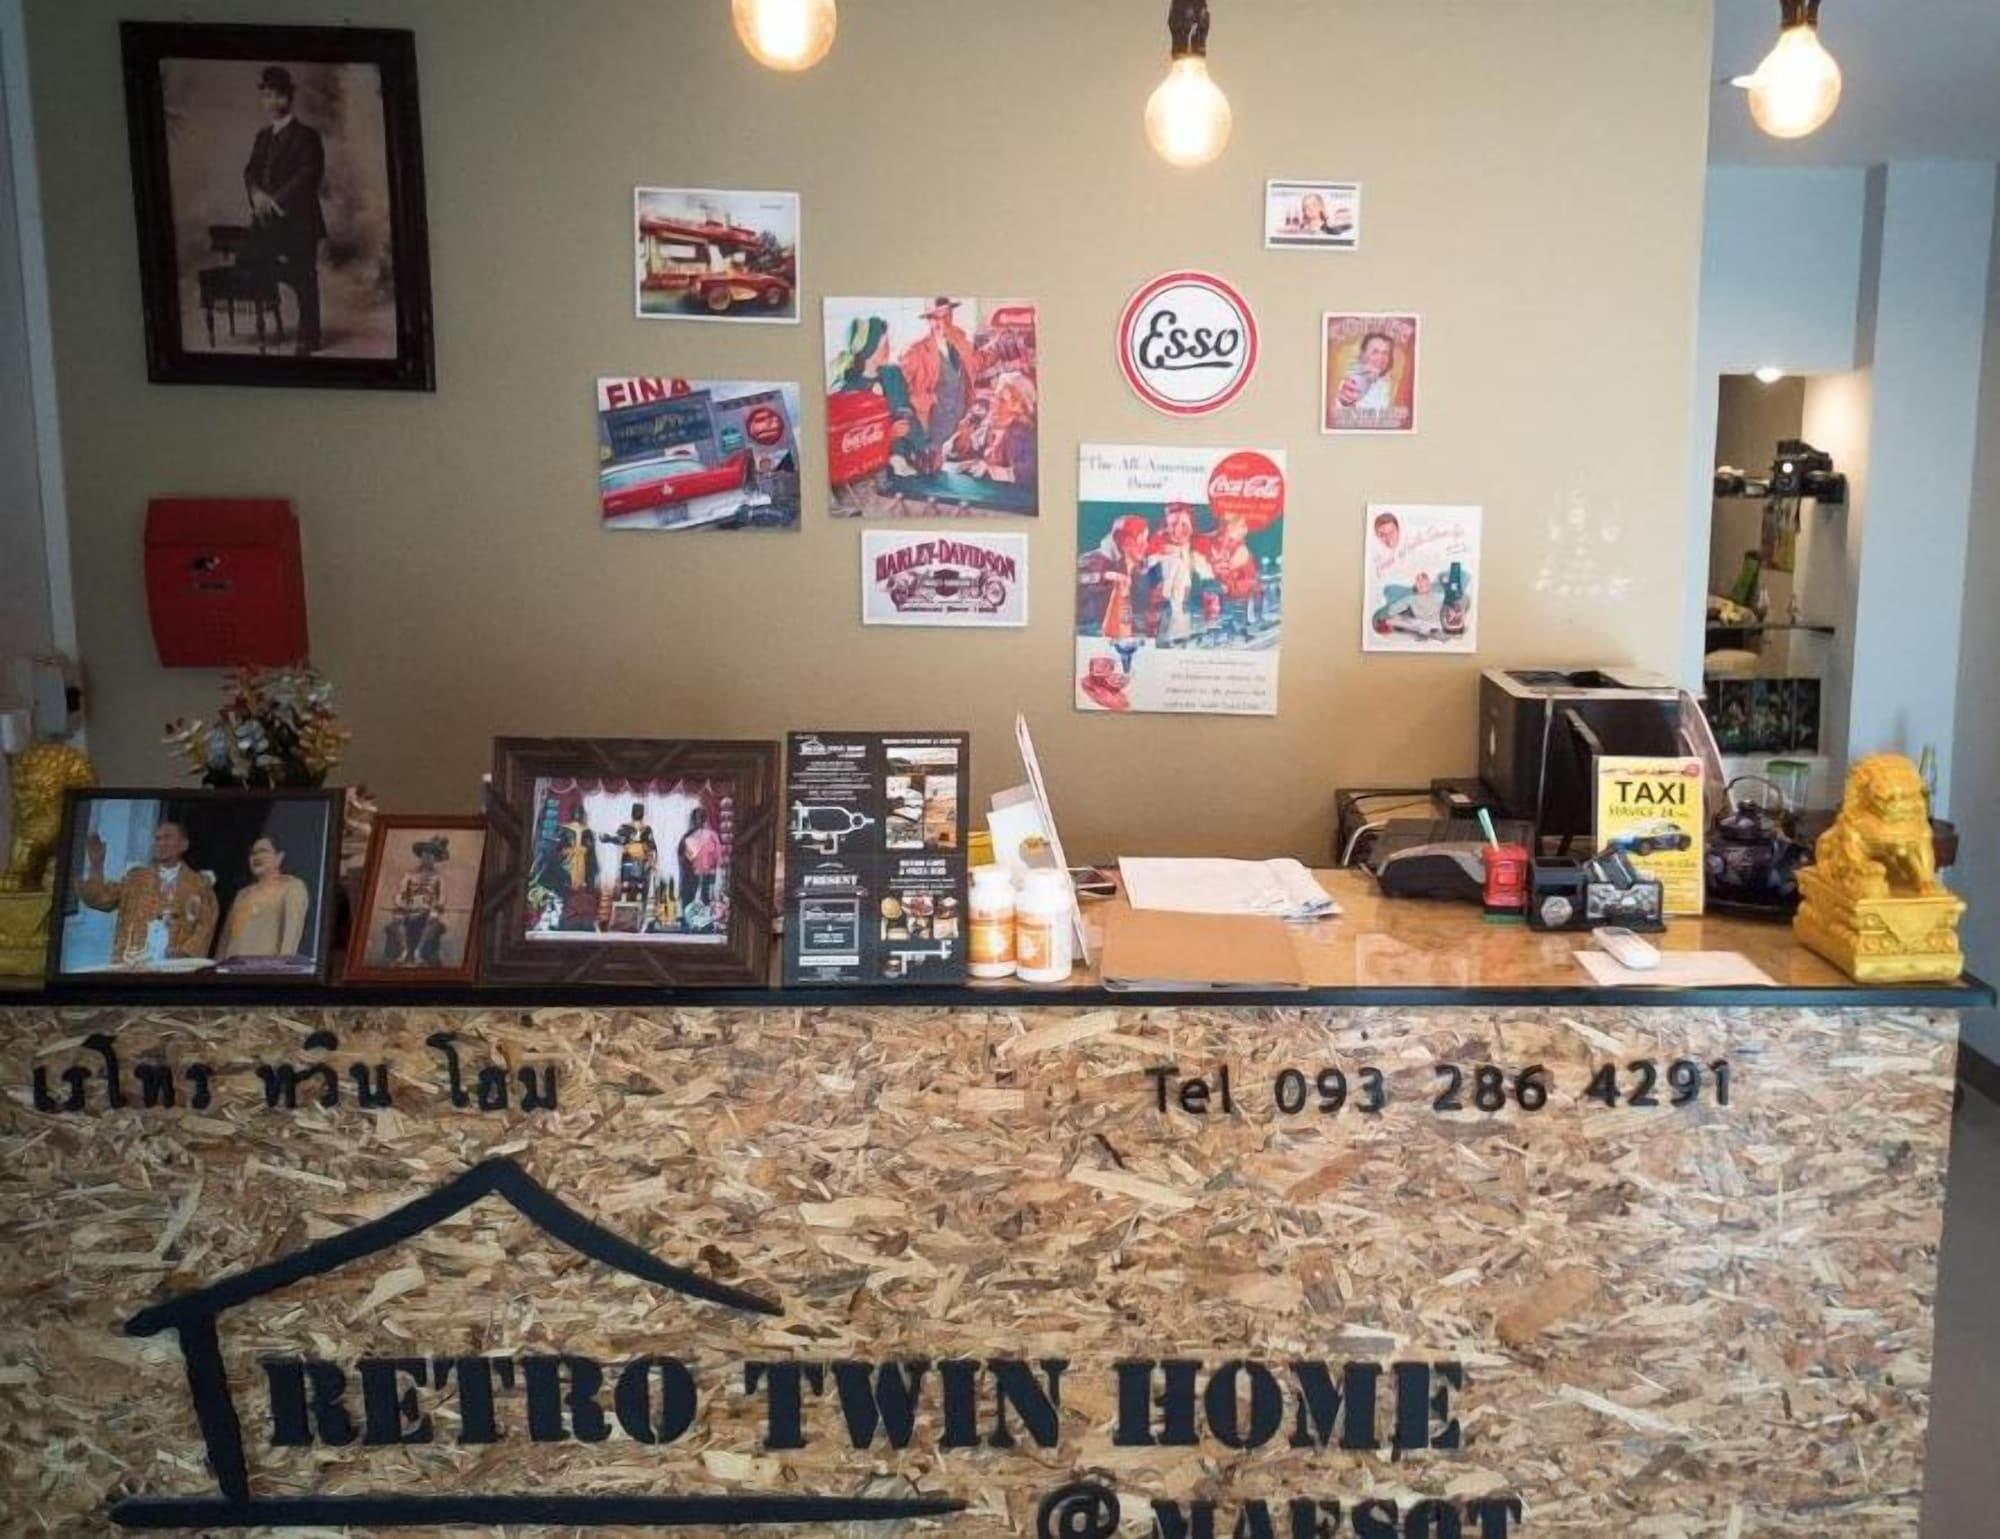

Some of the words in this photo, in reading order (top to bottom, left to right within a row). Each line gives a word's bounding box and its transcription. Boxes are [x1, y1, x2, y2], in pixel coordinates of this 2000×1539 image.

[1139, 310, 1239, 370] Esso
[605, 376, 691, 409] FINA
[875, 539, 1016, 583] HARLEY-DAVIDSON
[1614, 780, 1686, 804] TAXI
[803, 874, 859, 886] PRESENT
[33, 1032, 214, 1112] เรโทร
[256, 1030, 393, 1110] ทวิน
[426, 1032, 558, 1112] โฮม
[1145, 1064, 1233, 1115] Tel
[1274, 1066, 1386, 1115] 093
[1431, 1063, 1549, 1112] 286
[1584, 1058, 1730, 1108] 4291
[260, 1355, 699, 1448] RETRO
[743, 1358, 1071, 1451] TWIN
[1113, 1358, 1464, 1450] HOME
